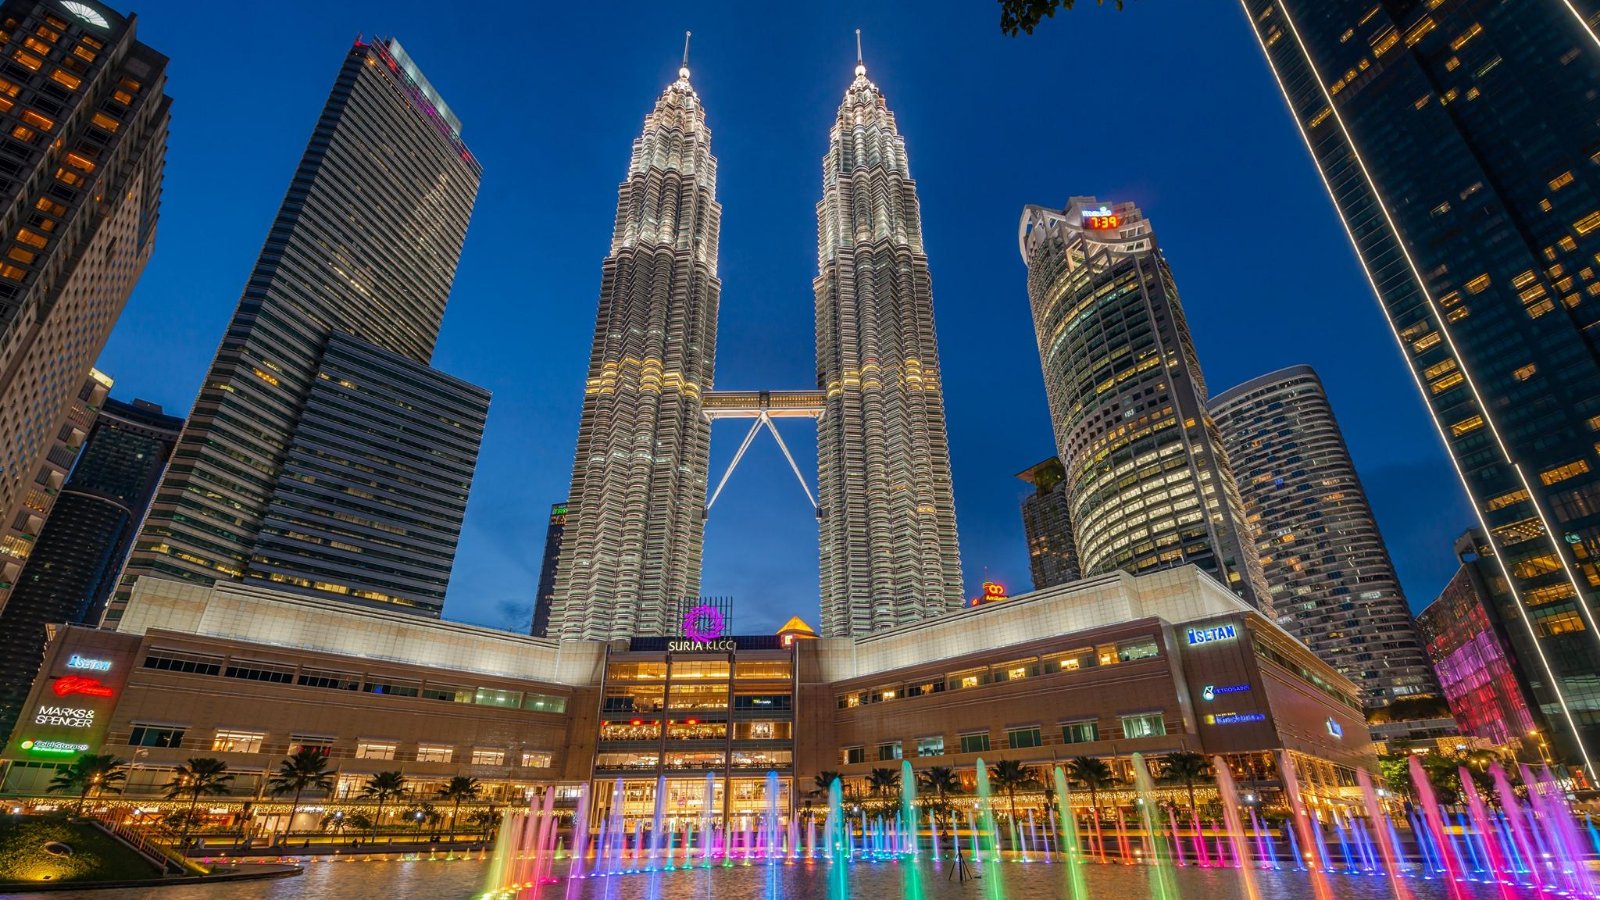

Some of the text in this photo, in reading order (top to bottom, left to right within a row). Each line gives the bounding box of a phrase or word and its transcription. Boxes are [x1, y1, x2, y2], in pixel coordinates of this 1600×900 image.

[1091, 216, 1117, 229] 7:39
[668, 640, 734, 651] SURIA KLCC
[39, 706, 95, 719] MARKS &
[35, 715, 93, 728] SPENCER
